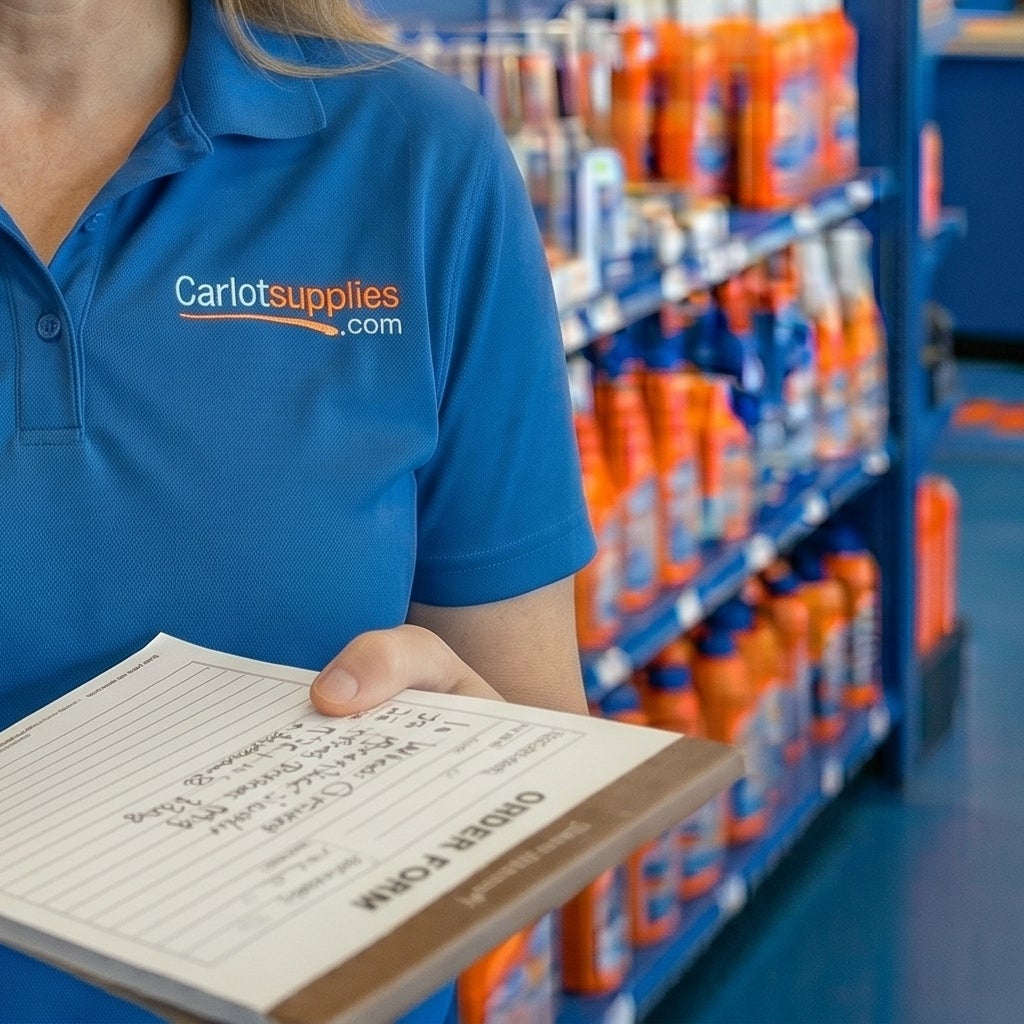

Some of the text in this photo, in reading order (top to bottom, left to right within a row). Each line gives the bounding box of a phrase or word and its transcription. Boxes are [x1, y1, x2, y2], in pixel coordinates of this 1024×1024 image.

[175, 275, 400, 318] Carlotsupplies
[340, 317, 403, 337] .com
[440, 790, 546, 853] ORDER
[351, 852, 451, 912] FORM
